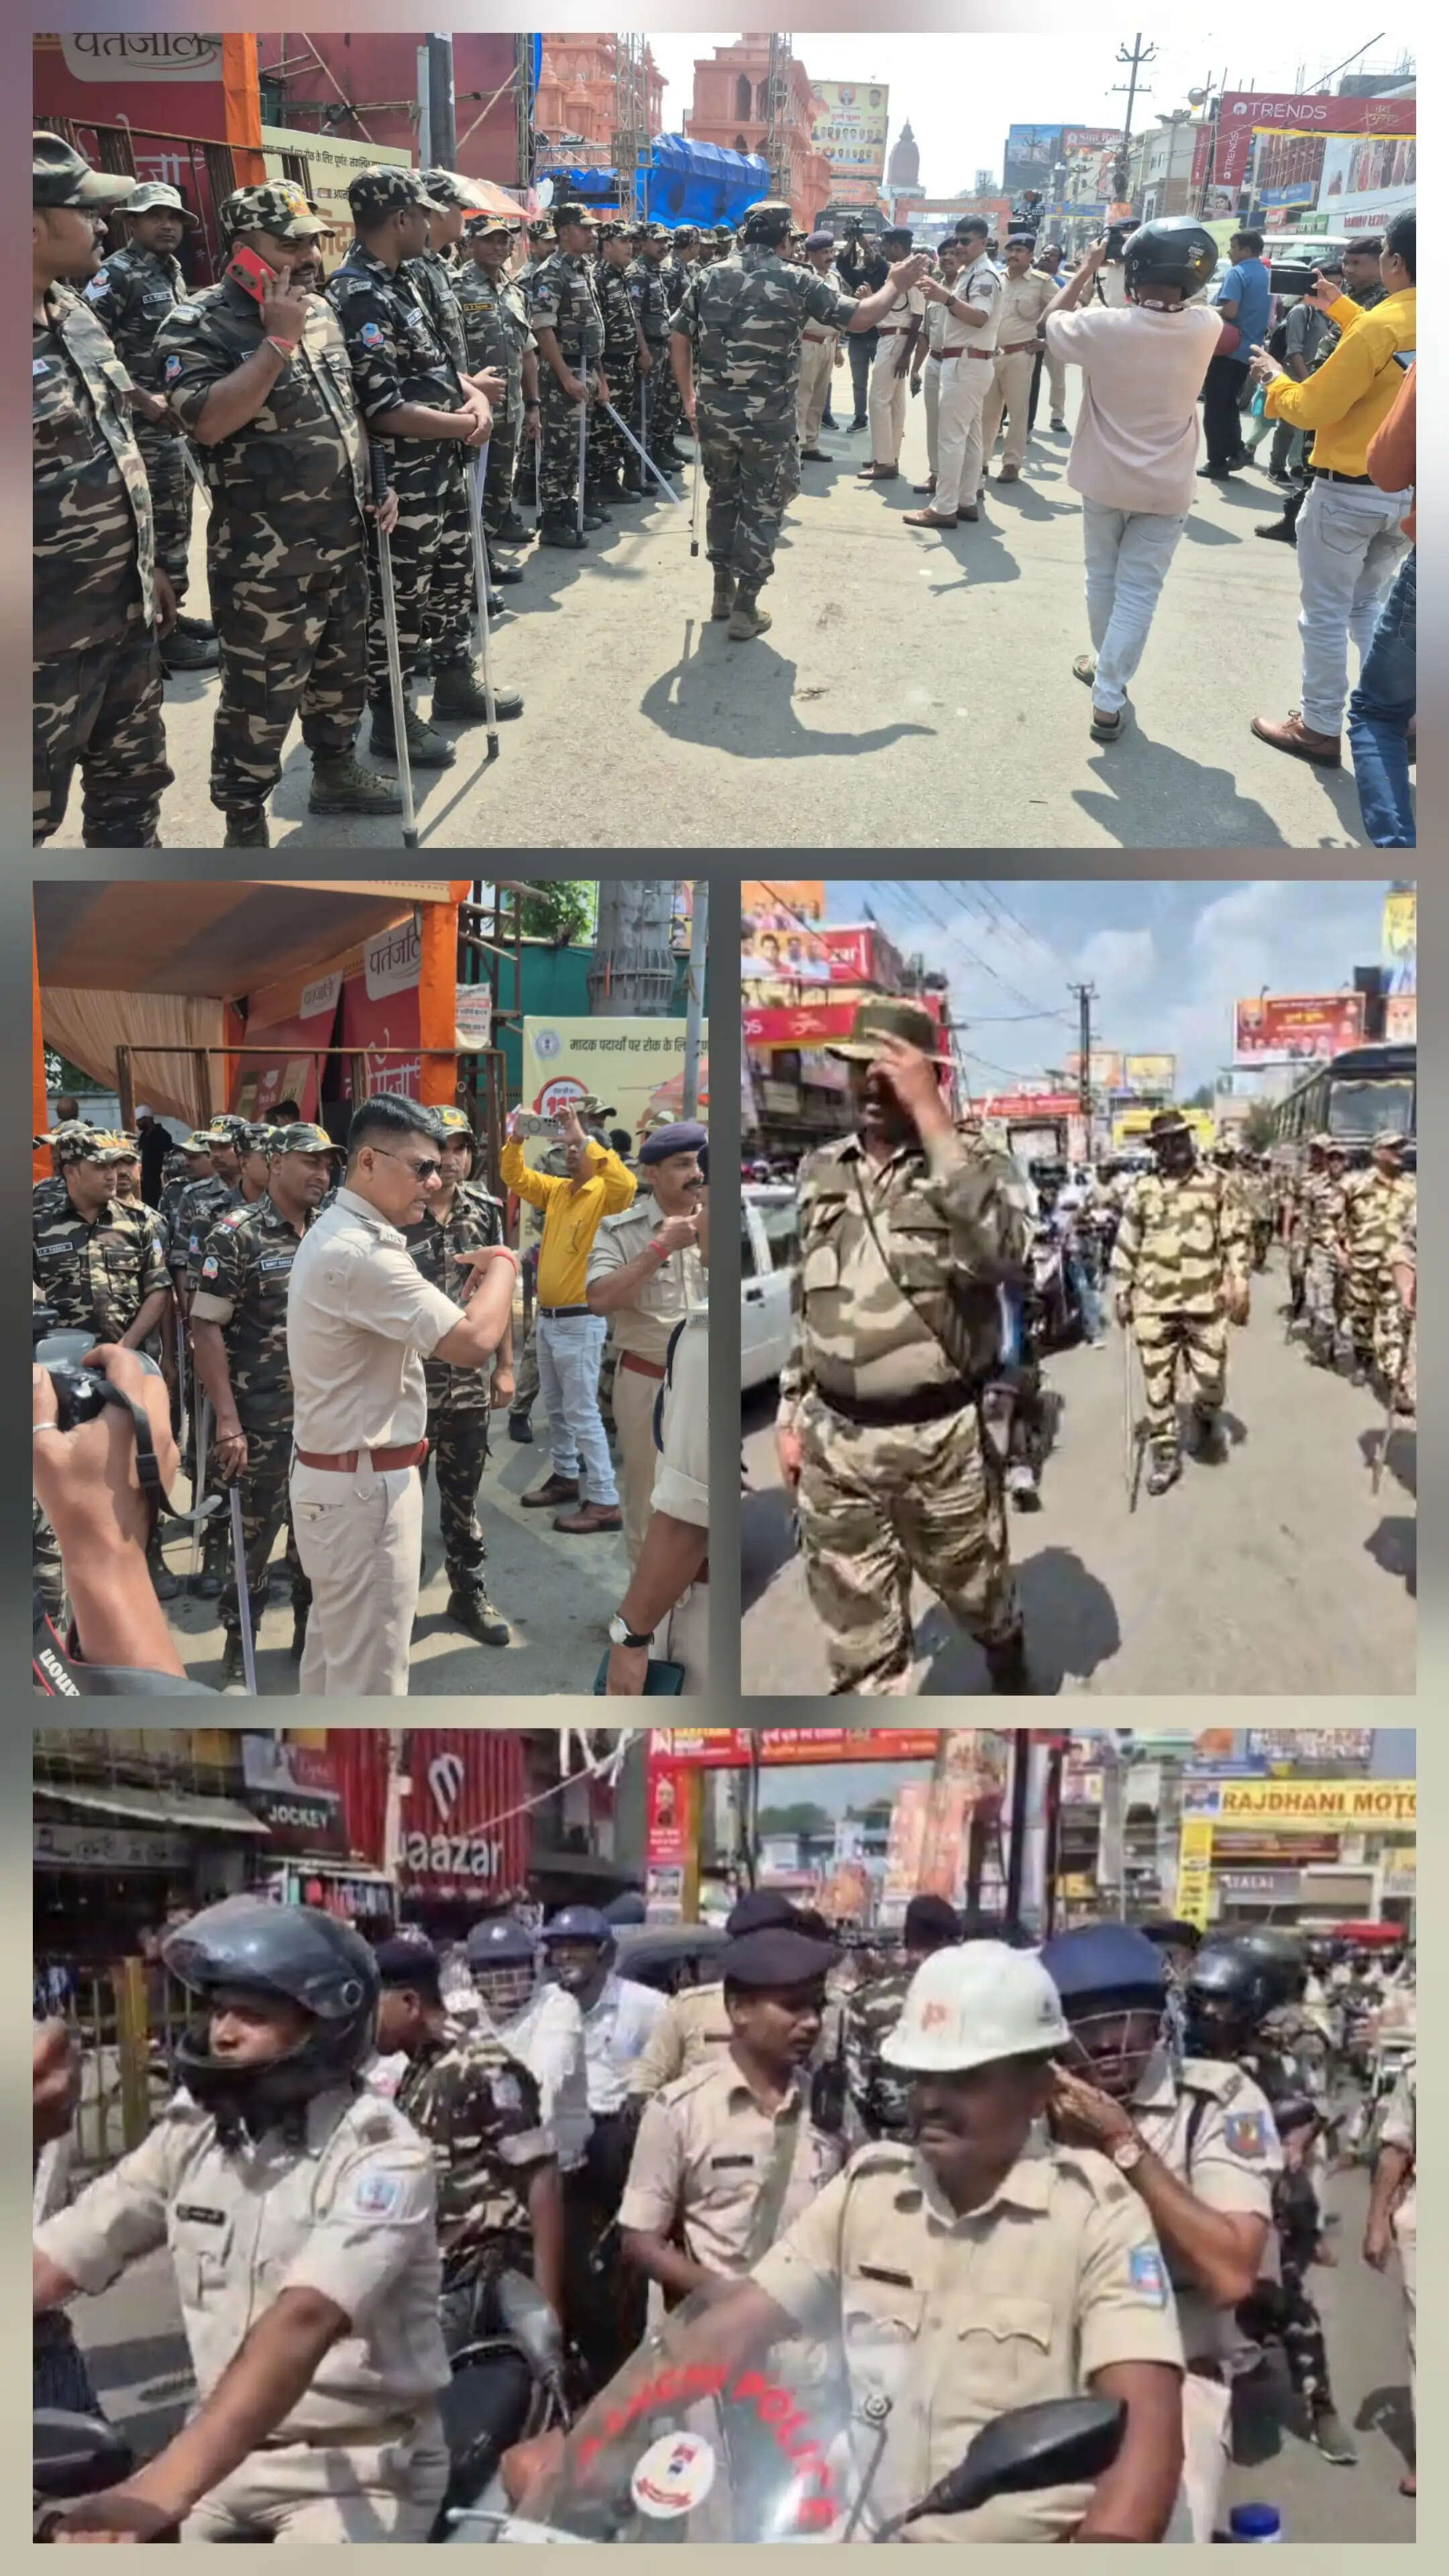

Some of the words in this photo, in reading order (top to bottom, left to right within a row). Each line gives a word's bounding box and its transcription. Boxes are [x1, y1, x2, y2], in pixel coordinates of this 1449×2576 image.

[1250, 102, 1328, 119] TRENDS
[1224, 131, 1239, 172] TRENDS
[570, 1039, 596, 1051] मादक
[629, 1039, 640, 1052] पर
[643, 1037, 661, 1052] रोक
[663, 1036, 672, 1052] के
[674, 1036, 687, 1052] लि
[1223, 1792, 1345, 1811] RAJDHANI
[268, 1804, 327, 1831] JOCKEY
